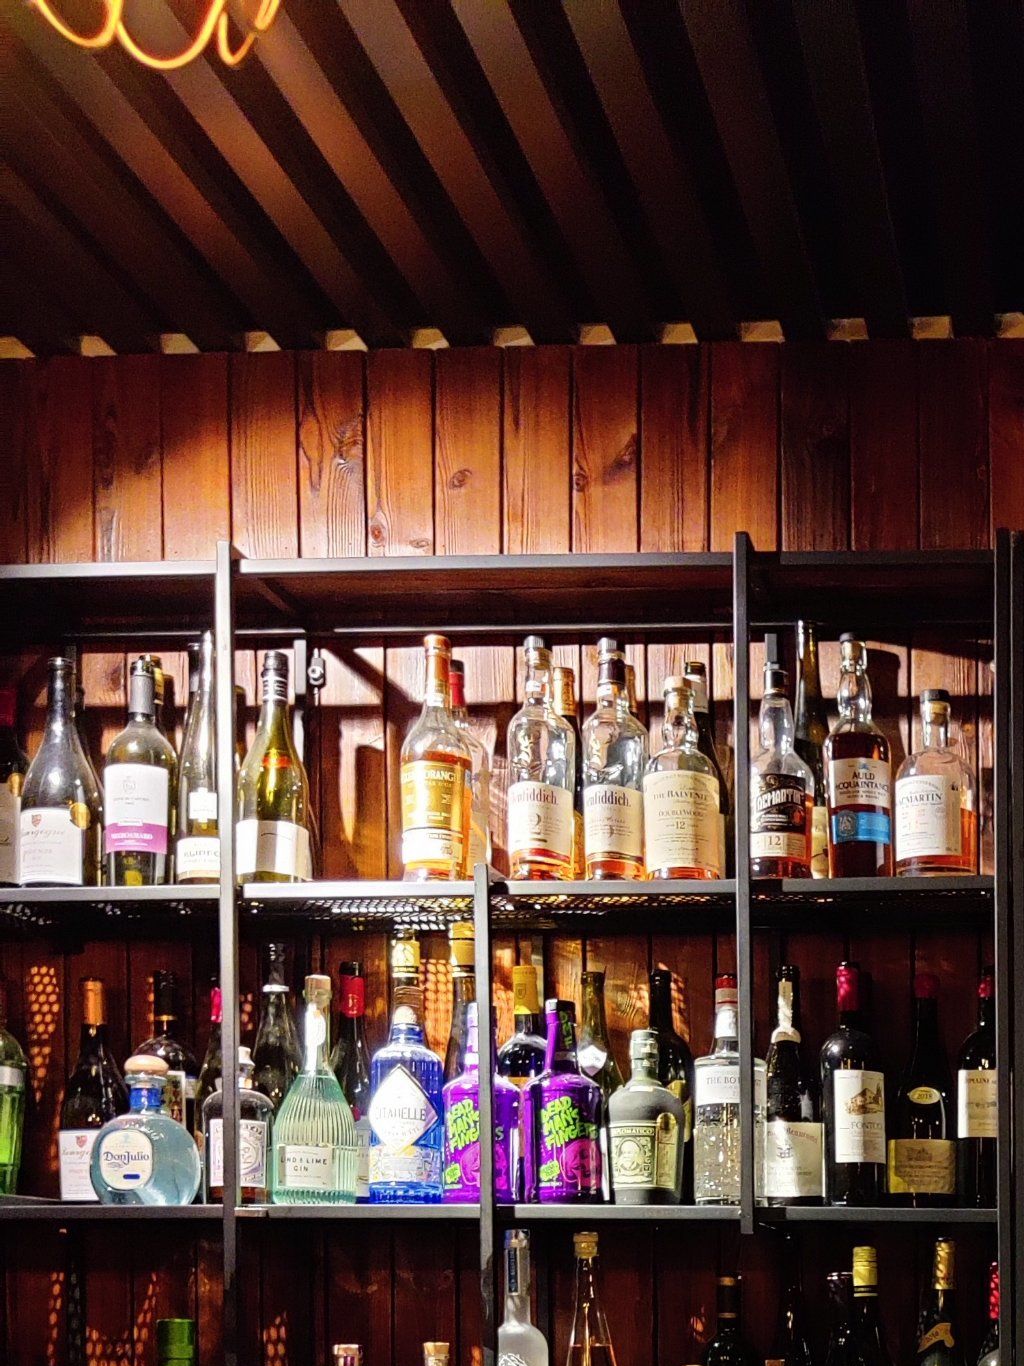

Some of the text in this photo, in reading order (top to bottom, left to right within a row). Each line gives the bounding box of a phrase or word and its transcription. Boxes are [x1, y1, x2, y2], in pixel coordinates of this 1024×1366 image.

[852, 771, 875, 781] AULD
[667, 790, 708, 801] BALVENIE
[675, 821, 686, 830] 12
[767, 835, 781, 846] 12
[706, 1076, 722, 1085] THE
[542, 1096, 572, 1123] DEAD
[545, 1122, 599, 1150] FINGERS
[104, 1151, 150, 1166] Don Julio
[306, 1157, 328, 1166] LIME
[293, 1165, 309, 1173] GIN
